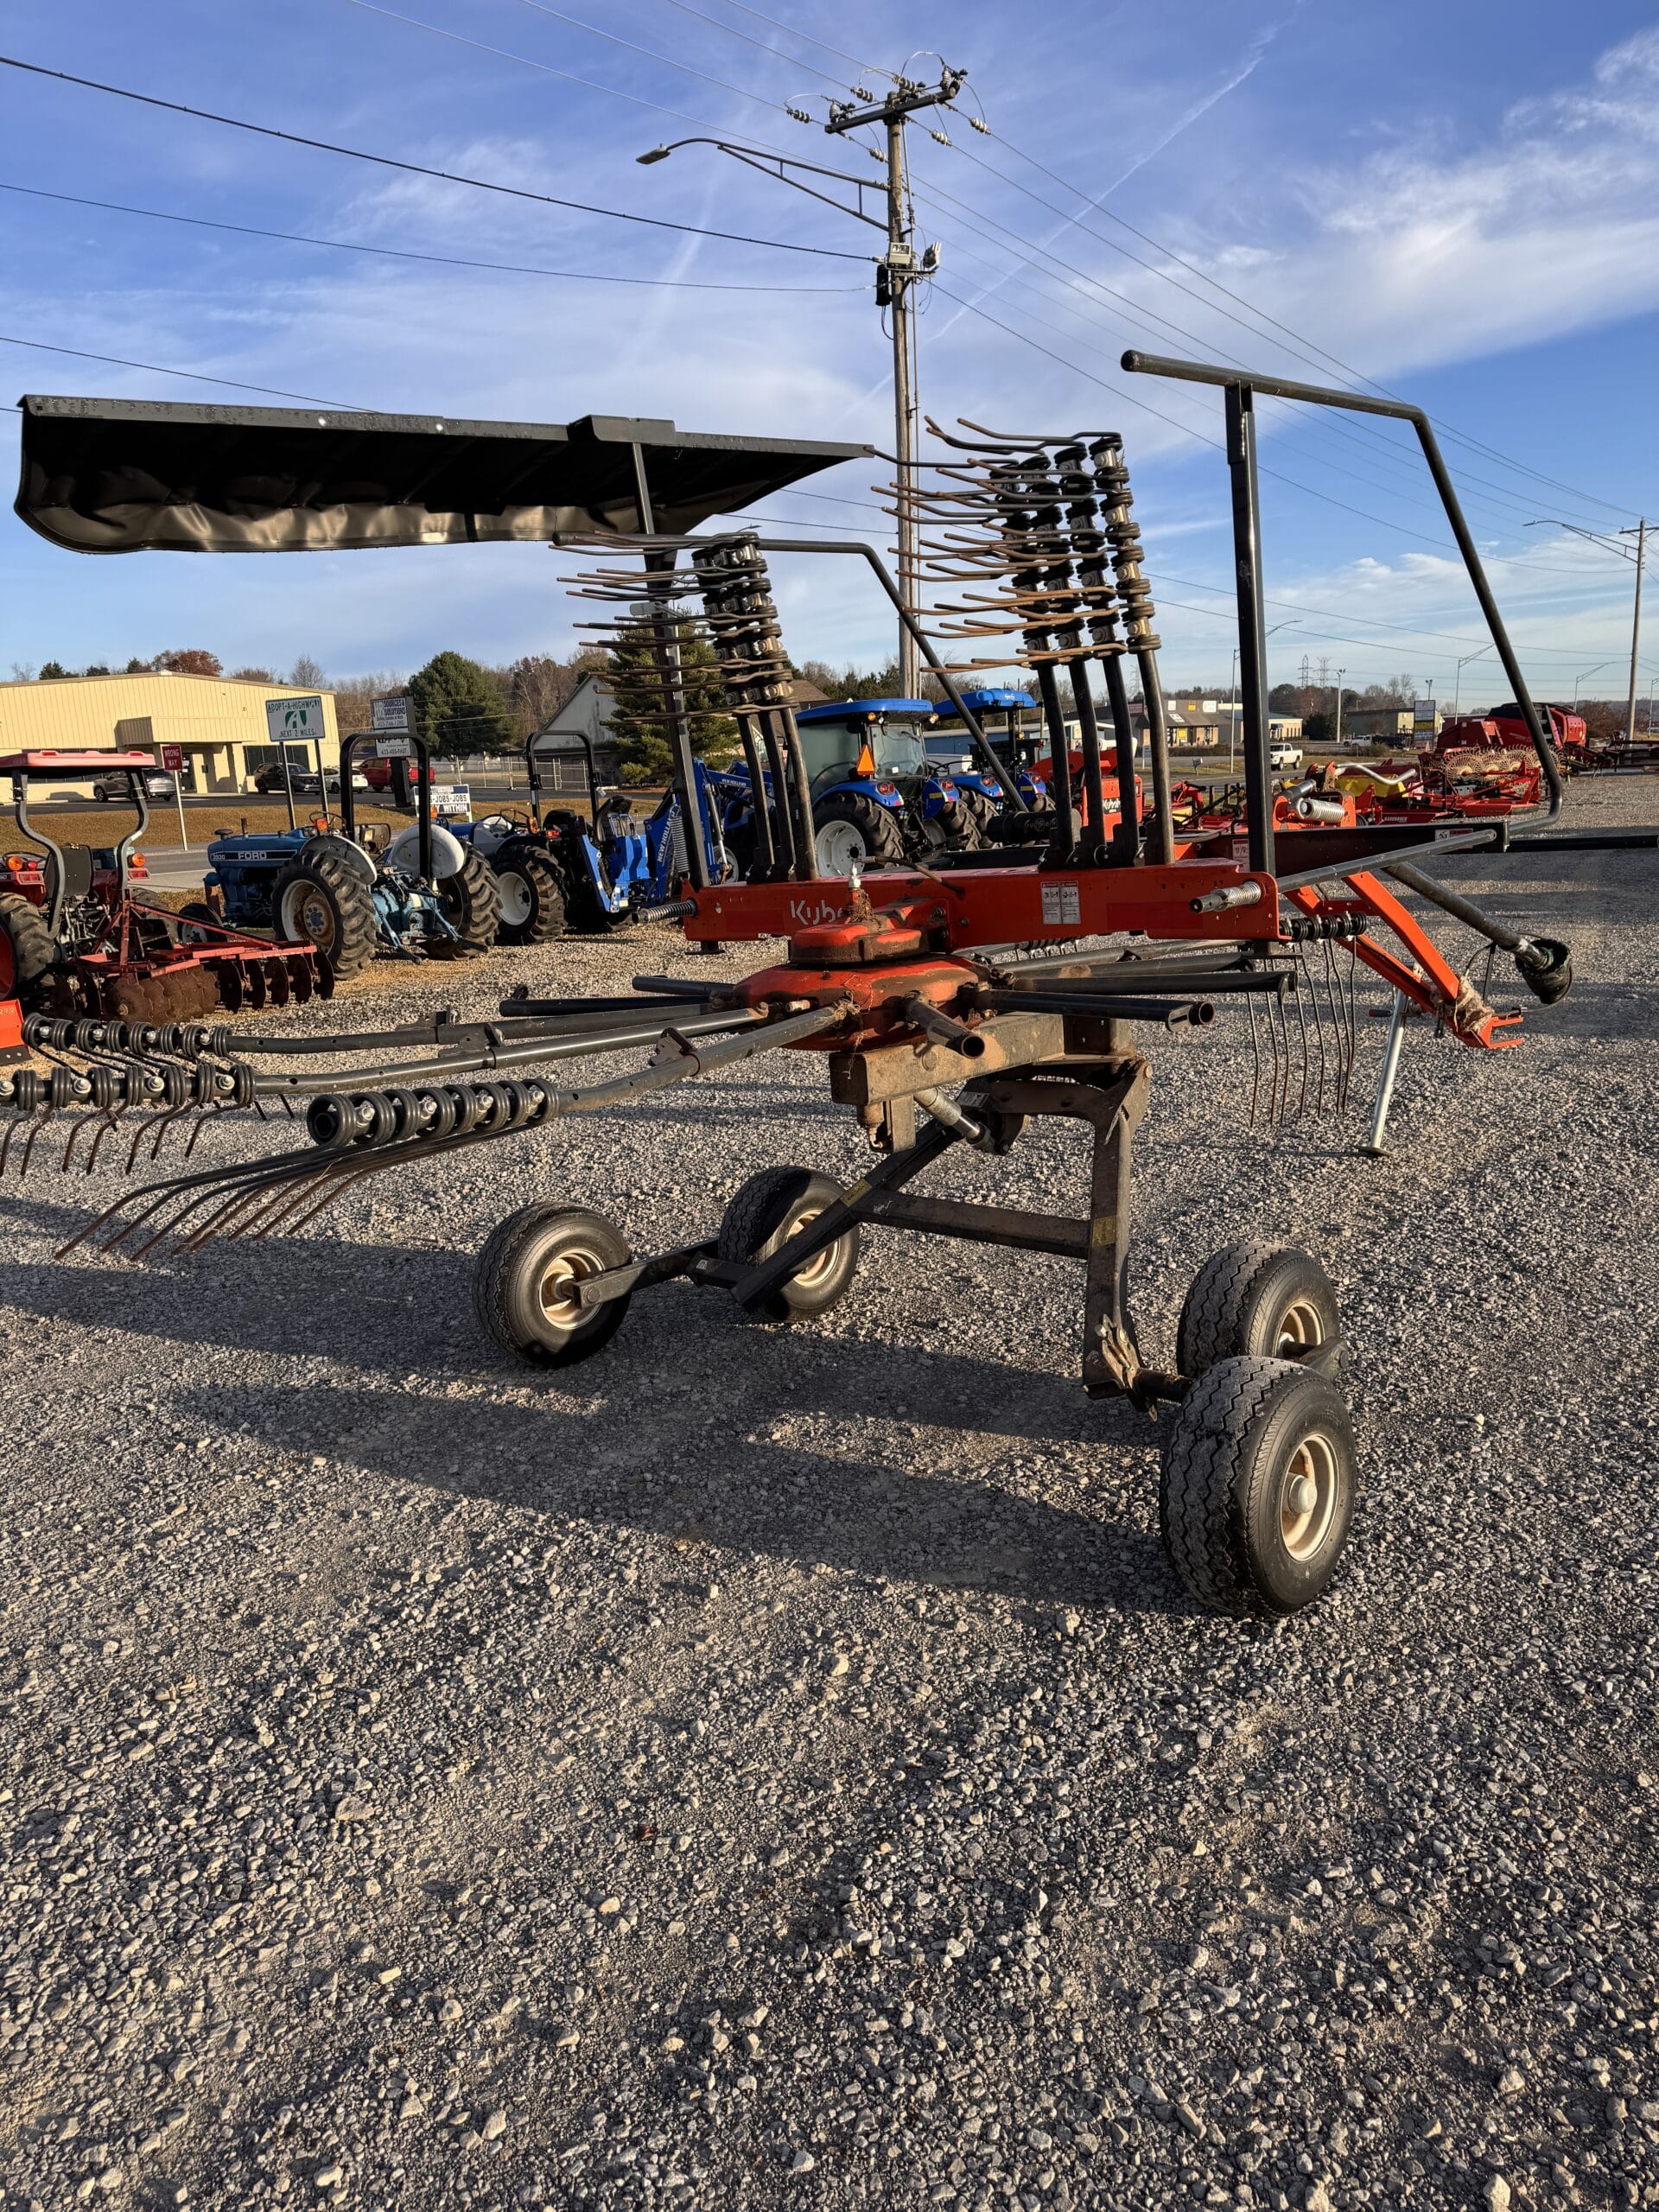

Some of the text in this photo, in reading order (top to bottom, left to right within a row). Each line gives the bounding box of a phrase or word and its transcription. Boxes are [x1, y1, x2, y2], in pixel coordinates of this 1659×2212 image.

[268, 698, 321, 713] ADOPT-A-HIGHWAY
[444, 804, 467, 812] WITHIN
[238, 851, 267, 860] FORD
[657, 844, 665, 862] NEW
